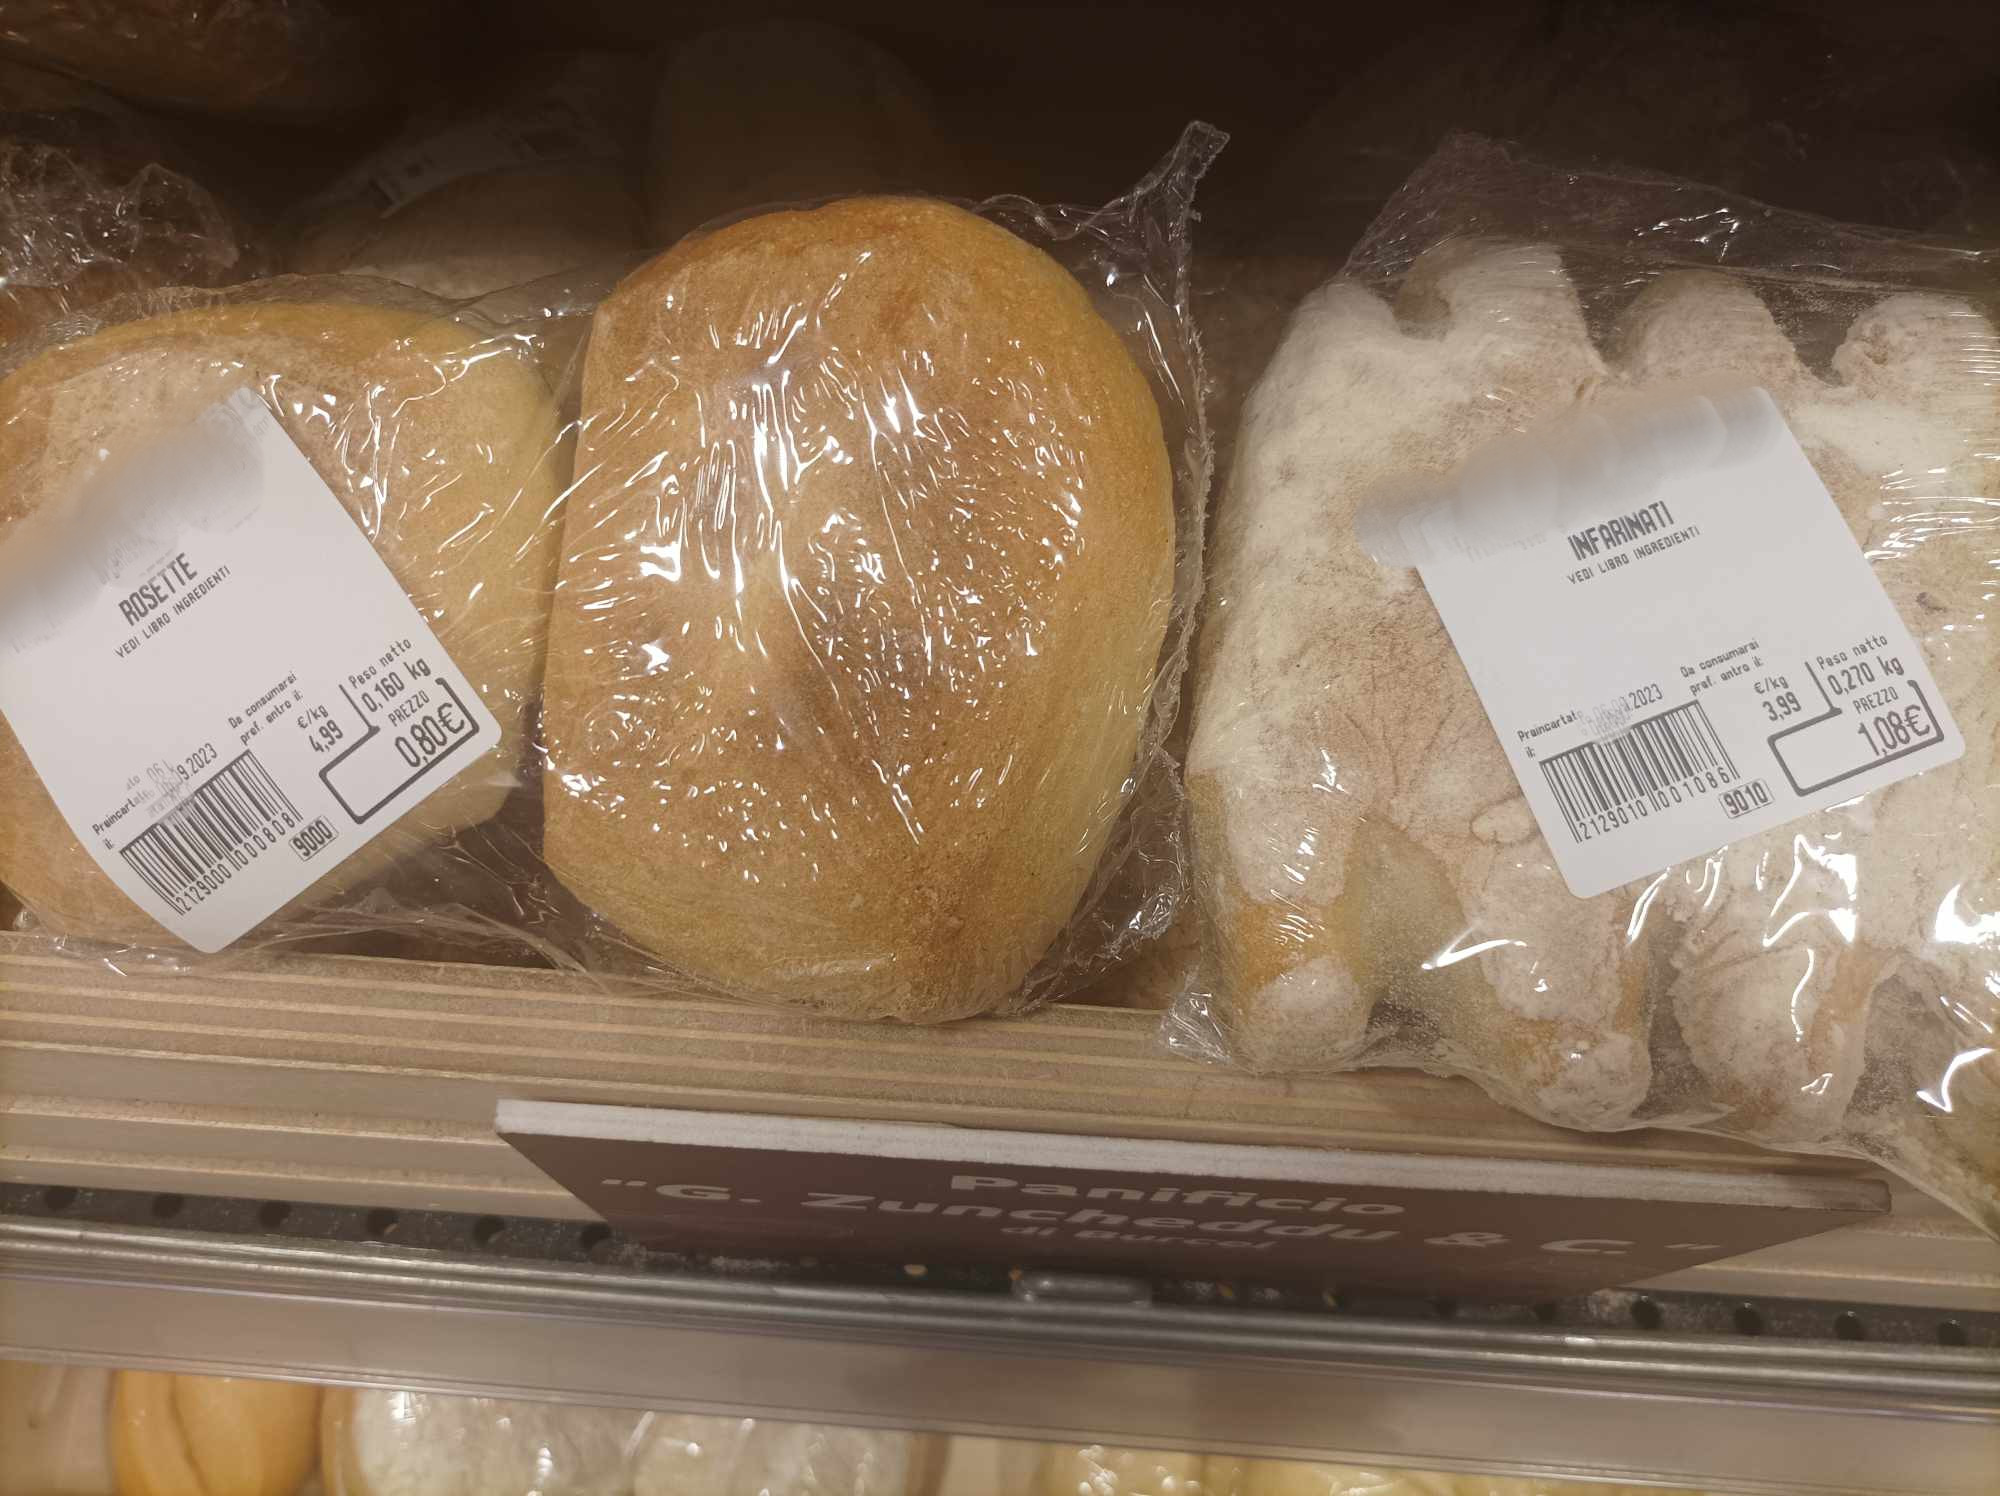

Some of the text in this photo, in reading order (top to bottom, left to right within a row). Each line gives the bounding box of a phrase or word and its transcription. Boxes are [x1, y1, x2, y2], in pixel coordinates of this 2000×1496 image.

[1567, 500, 1674, 561] INFARINATI
[1567, 525, 1701, 585] VEDI LIBRO INGREDIENTI
[118, 552, 198, 627] ROSETTE
[114, 565, 232, 659] VEDI LIBRO INGREDIENTI
[348, 638, 413, 689] Peso netto
[1680, 639, 1760, 679] Da consumarsi
[1816, 635, 1888, 671] Peso netto
[361, 658, 432, 713] 0,160 kg
[1690, 675, 1716, 697] pref.
[1720, 663, 1751, 683] entro
[1753, 674, 1789, 695] €/kg
[1827, 656, 1905, 696] 0,270 kg
[227, 671, 297, 729] Da consumarsi
[297, 704, 329, 730] €/kg
[387, 690, 431, 728] PREZZO
[1761, 691, 1802, 722] 3,99
[1852, 686, 1899, 716] PREZZO
[240, 724, 265, 747] pref.
[266, 700, 293, 724] entro
[308, 719, 344, 753] 4,99
[394, 702, 466, 769] 0,80€
[1857, 704, 1931, 758] 1,08€
[1722, 781, 1769, 817] 9010
[292, 820, 333, 858] 9000
[950, 1174, 1405, 1217] Panificio
[800, 1192, 1402, 1241] Zuncheddu
[1423, 1231, 1512, 1248] &
